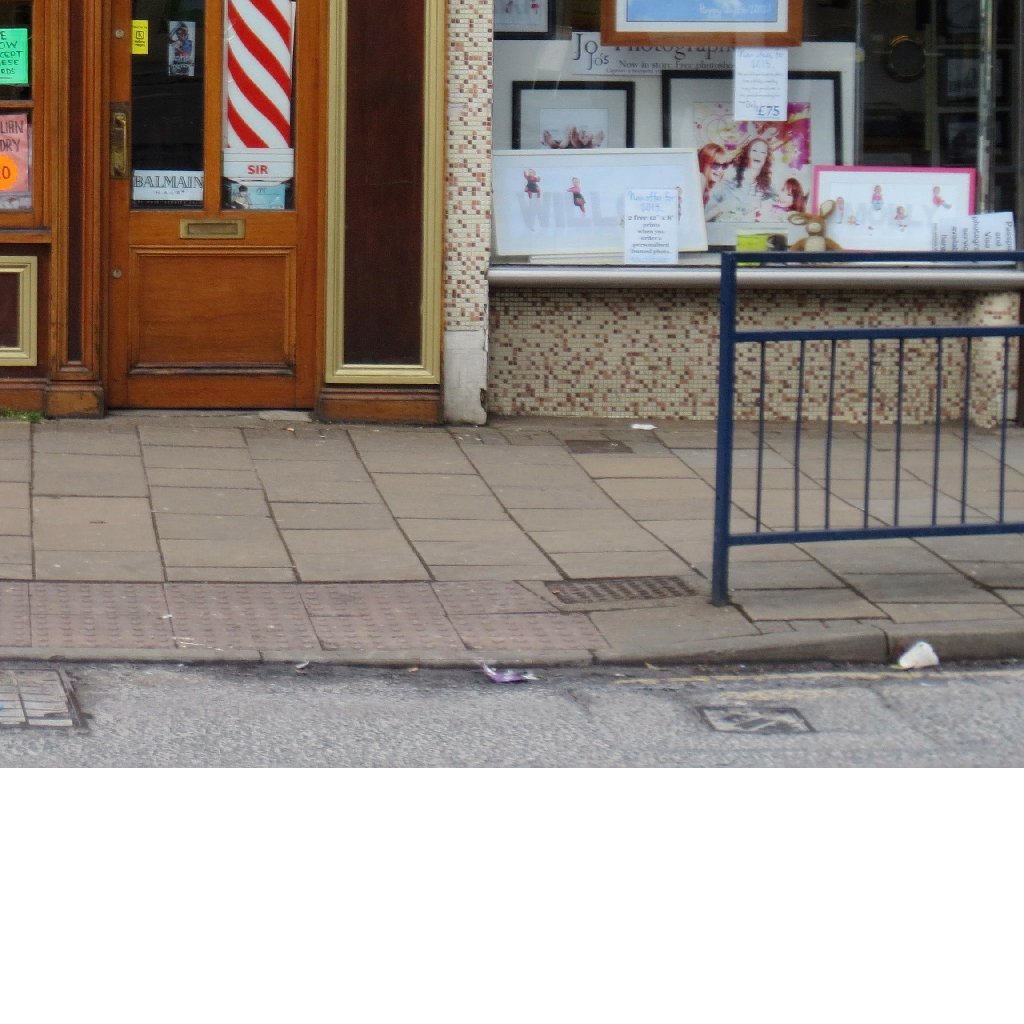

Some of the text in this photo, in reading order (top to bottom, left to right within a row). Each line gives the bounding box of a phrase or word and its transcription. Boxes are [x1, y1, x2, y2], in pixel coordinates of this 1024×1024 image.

[573, 33, 598, 61] Jo
[619, 59, 639, 68] Now
[757, 105, 780, 117] £75
[247, 164, 269, 175] SIR
[134, 176, 203, 189] BALMAIN
